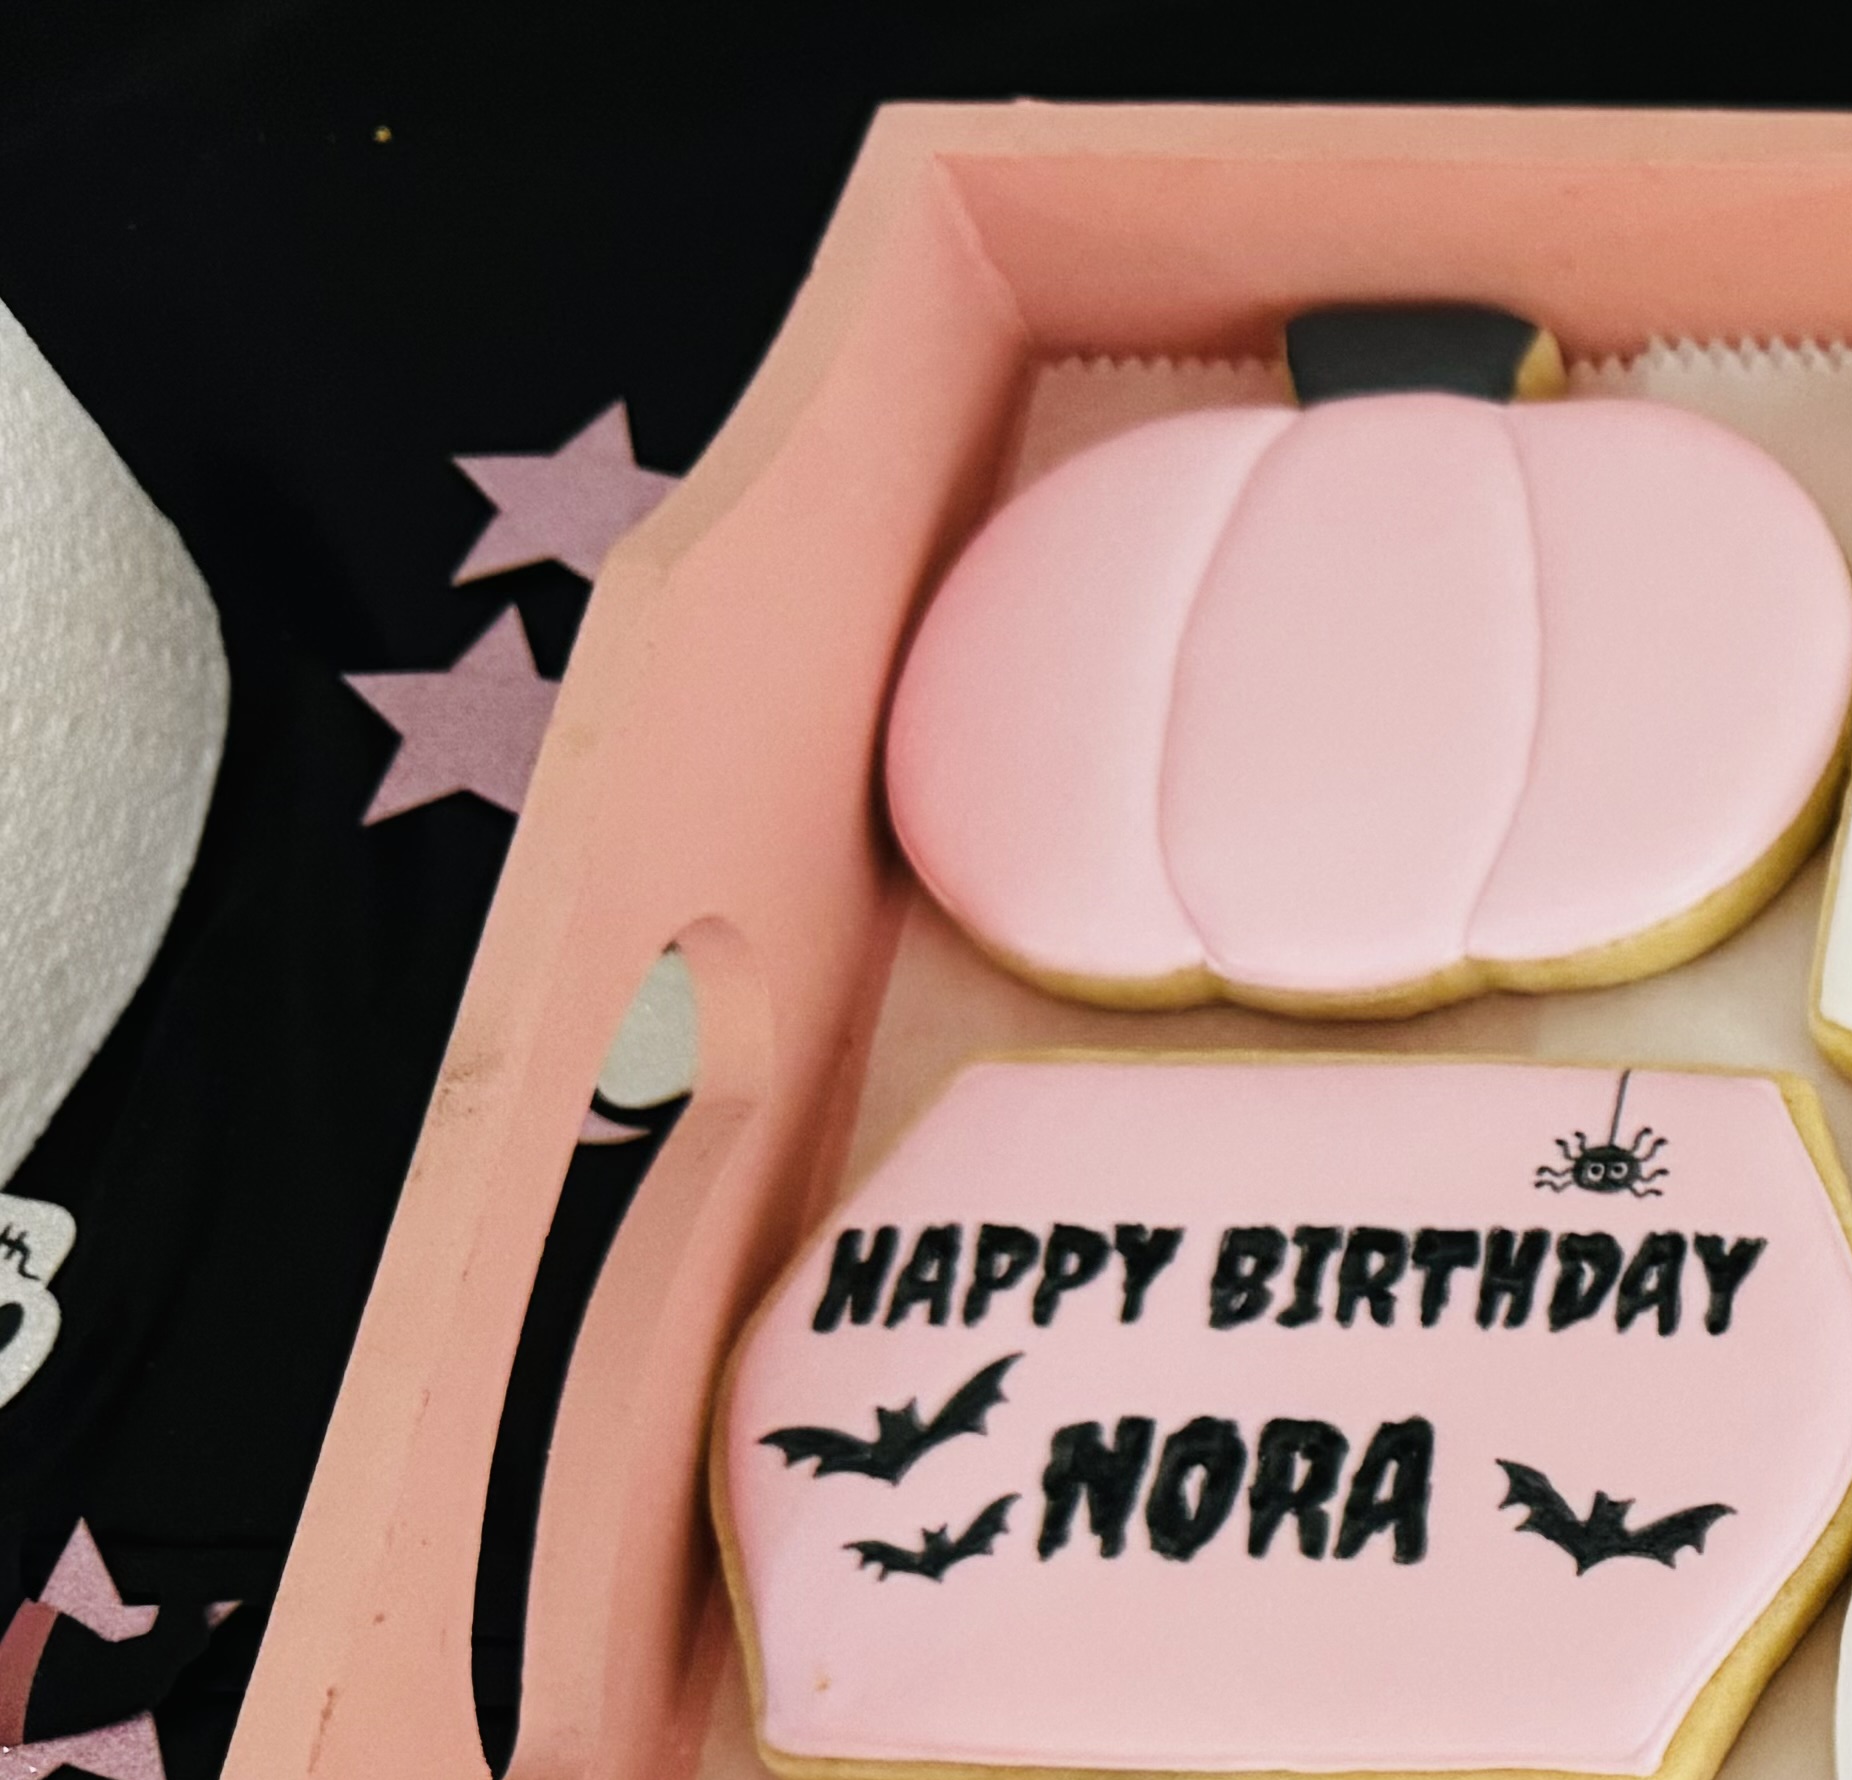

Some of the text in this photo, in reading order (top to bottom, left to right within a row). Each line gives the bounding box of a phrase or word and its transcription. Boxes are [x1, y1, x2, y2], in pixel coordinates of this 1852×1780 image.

[810, 1221, 1768, 1338] HAPPY BIRTHDAY
[1035, 1413, 1436, 1566] NORA
